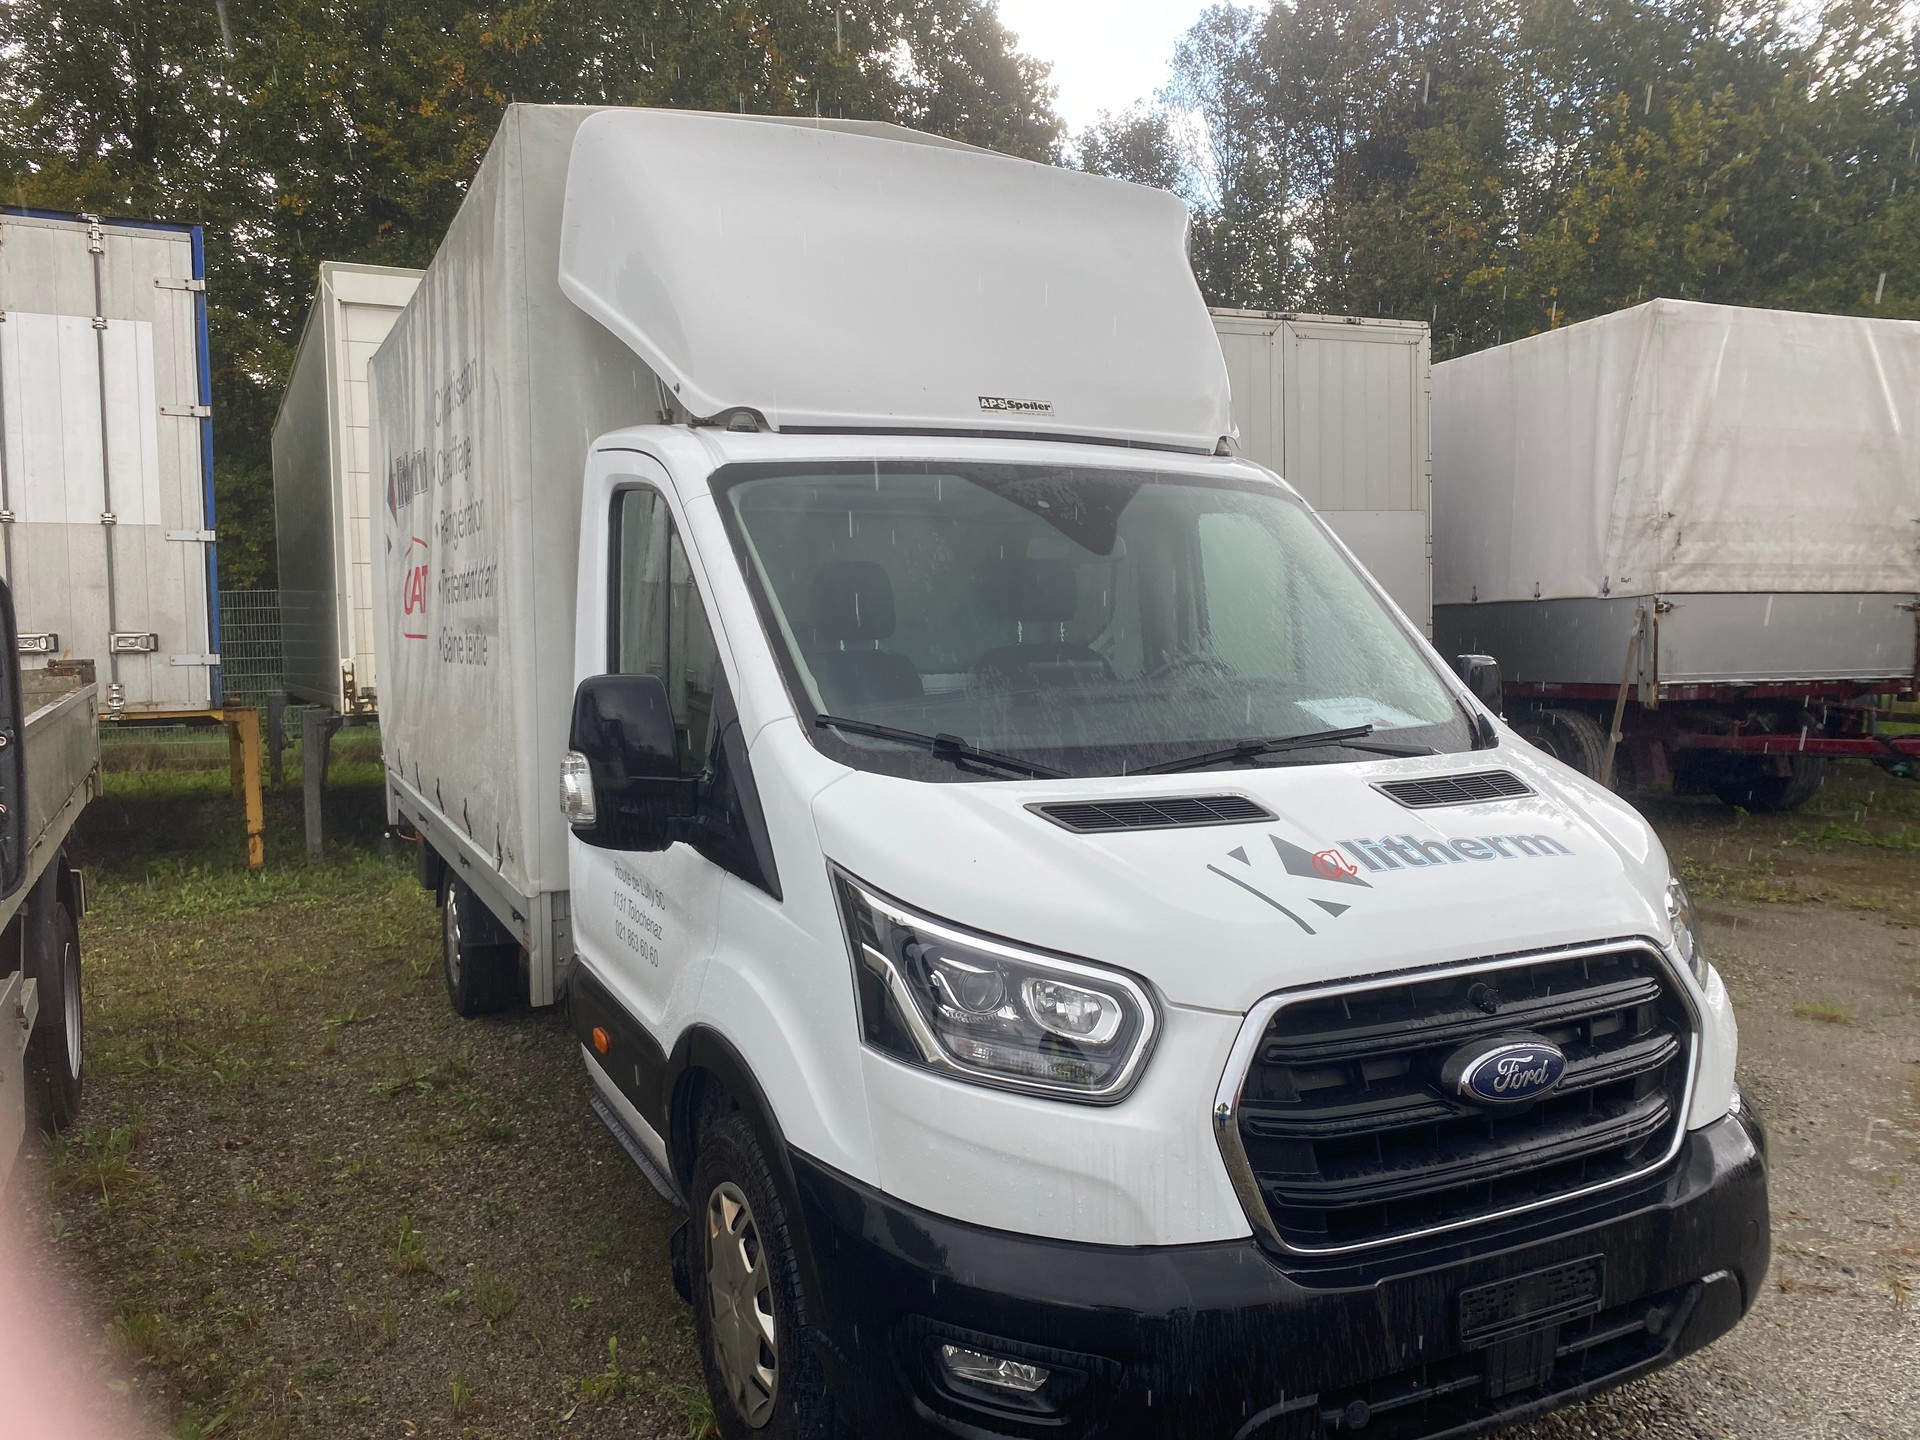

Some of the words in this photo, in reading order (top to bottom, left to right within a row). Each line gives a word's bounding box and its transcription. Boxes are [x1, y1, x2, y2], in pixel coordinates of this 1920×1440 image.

[980, 398, 1006, 409] APS
[1006, 400, 1051, 411] Spoiler
[403, 565, 429, 616] CAT
[442, 626, 464, 664] Gaine
[613, 860, 631, 887] Route
[631, 873, 640, 892] de
[613, 889, 627, 913] 1131
[628, 898, 663, 941] Tolochenaz
[615, 919, 626, 941] 021
[627, 928, 640, 952] 863
[640, 938, 649, 960] 60
[649, 946, 659, 968] 60
[1493, 1054, 1550, 1093] Ford
